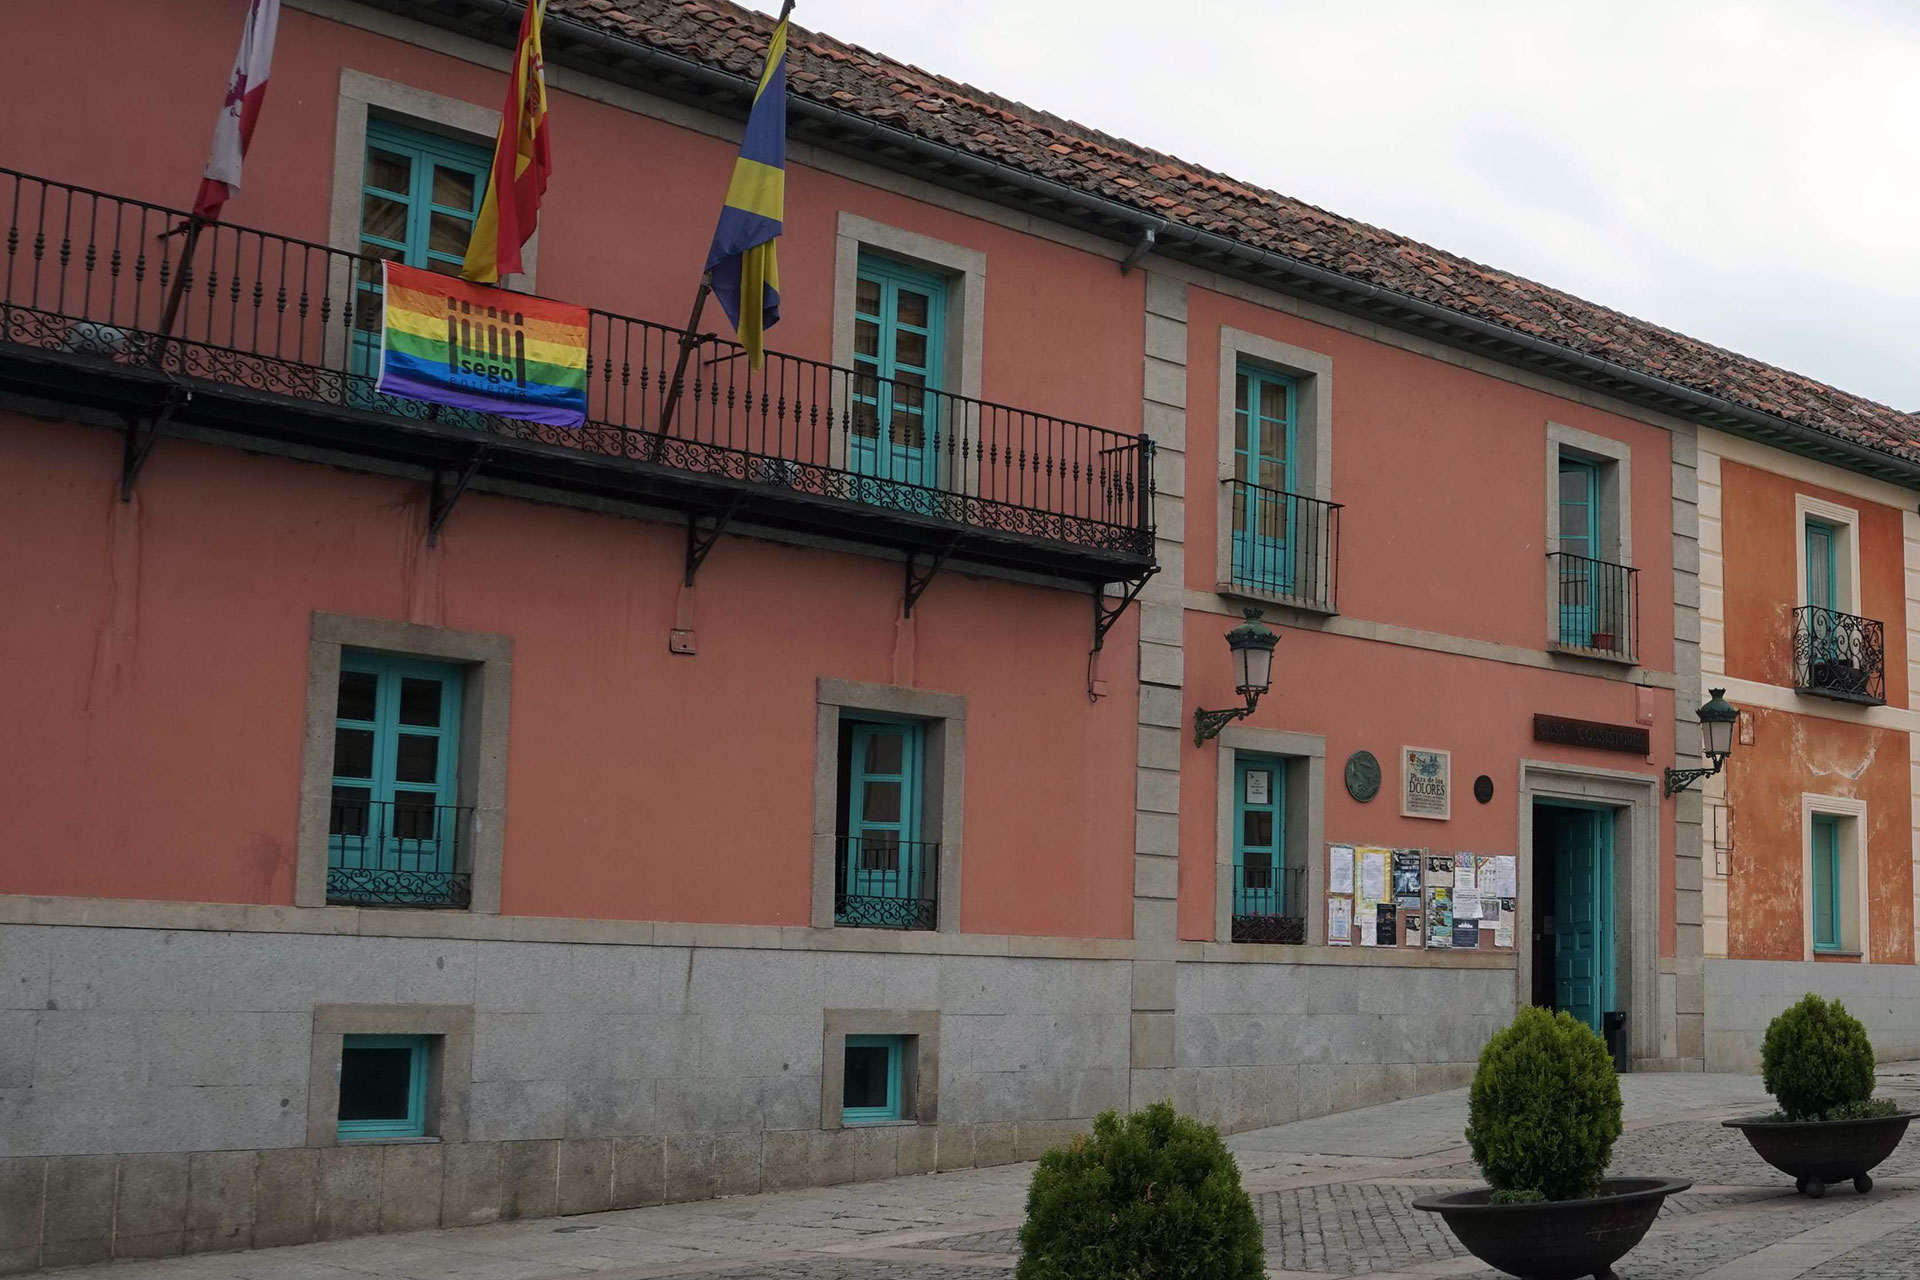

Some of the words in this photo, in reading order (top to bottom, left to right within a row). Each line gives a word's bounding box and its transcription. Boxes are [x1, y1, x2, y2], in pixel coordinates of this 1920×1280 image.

[461, 359, 514, 384] sego
[1537, 718, 1567, 737] CASA
[1410, 772, 1426, 782] Plaza
[1409, 780, 1445, 796] DOLORES
